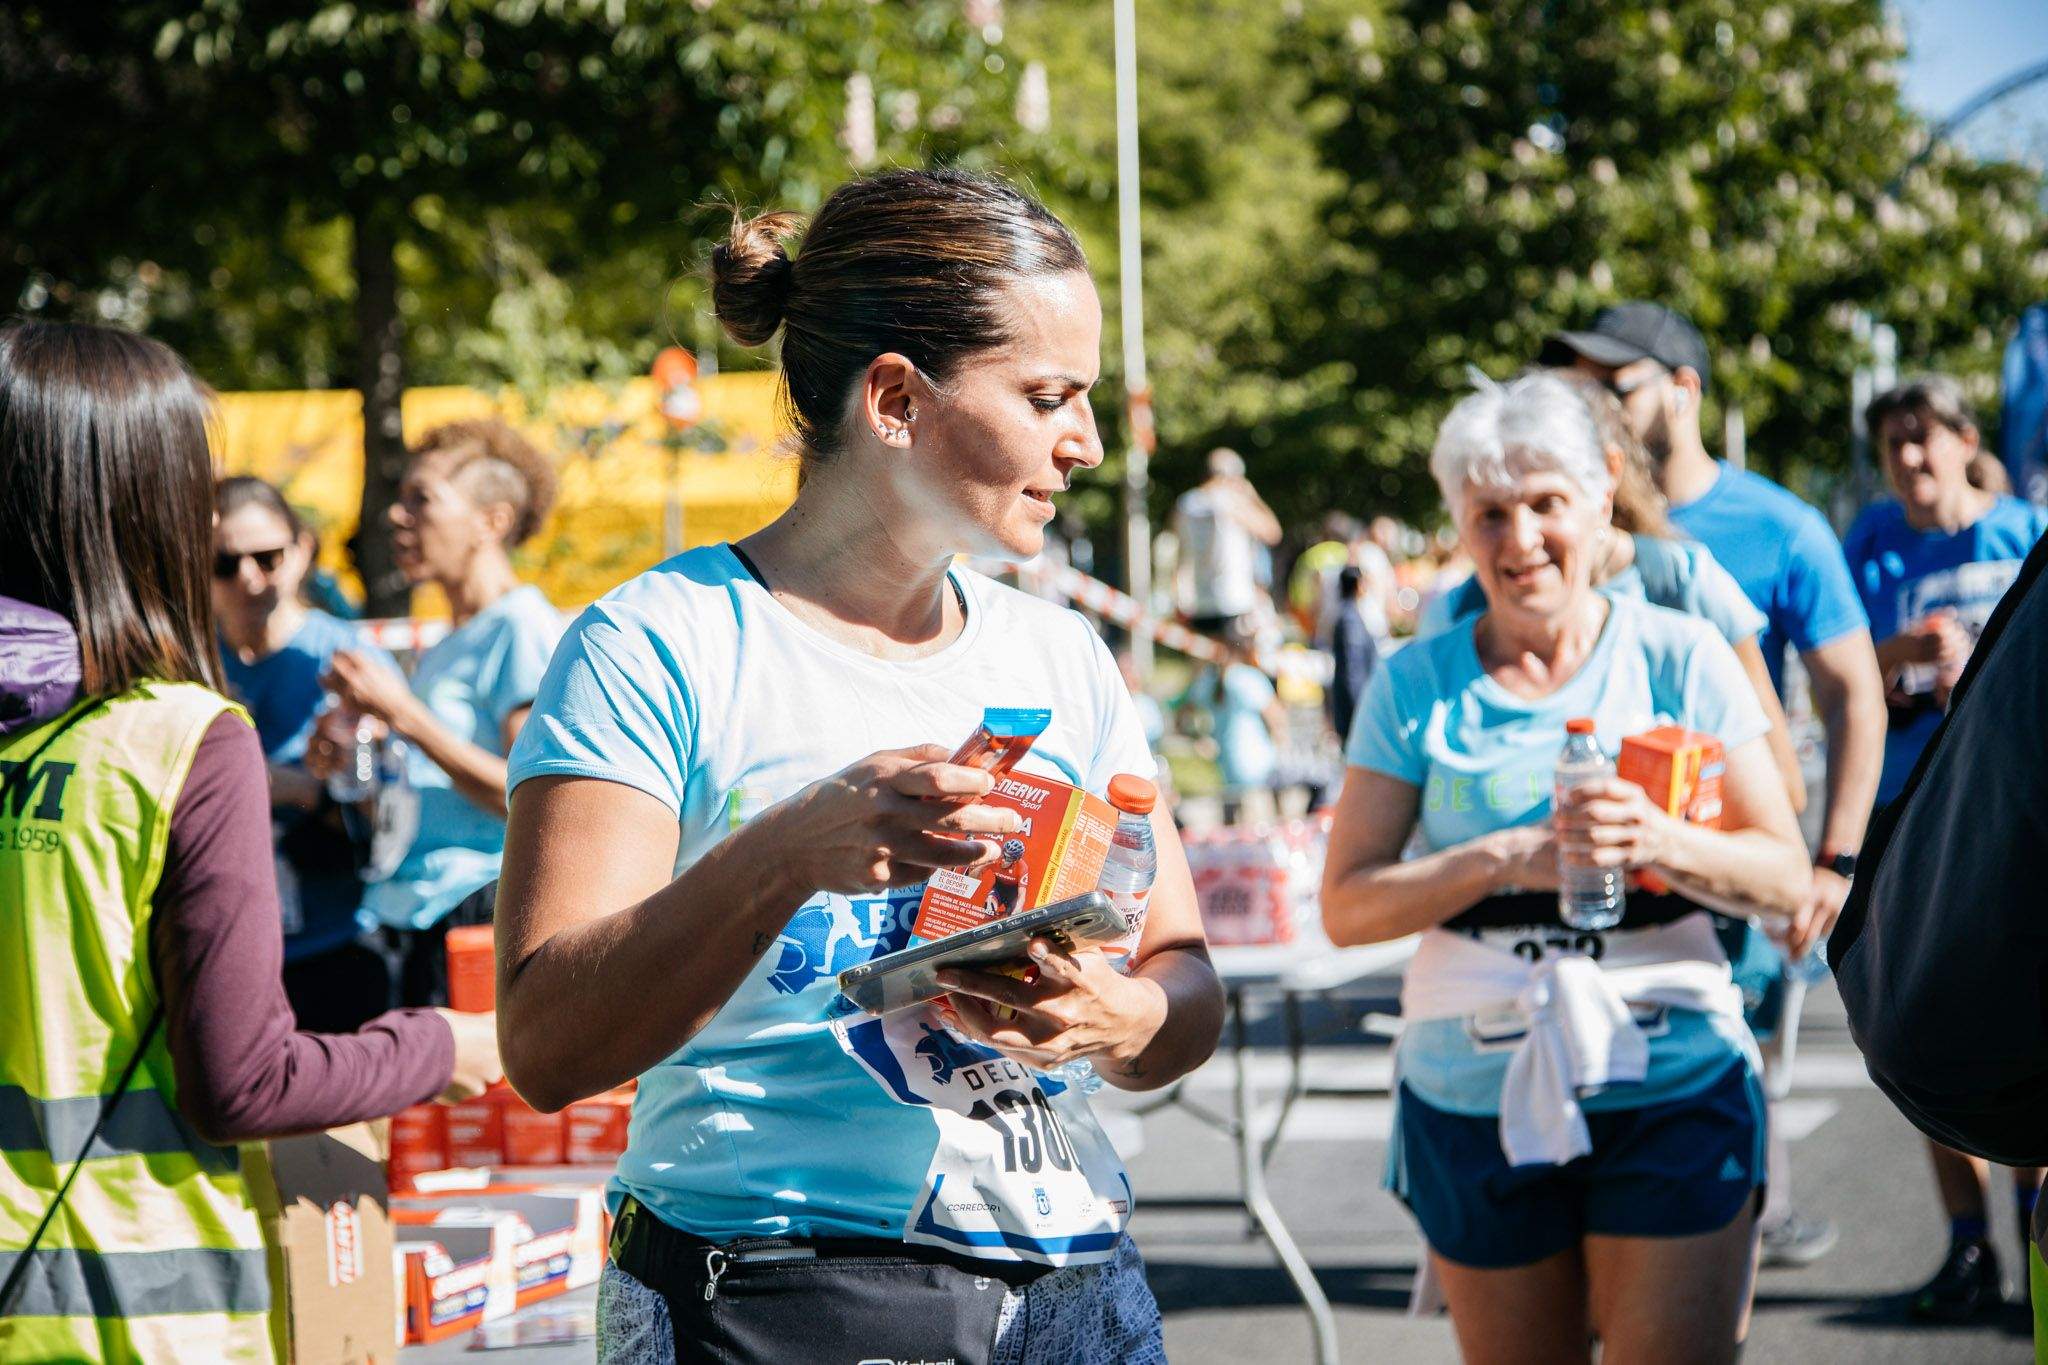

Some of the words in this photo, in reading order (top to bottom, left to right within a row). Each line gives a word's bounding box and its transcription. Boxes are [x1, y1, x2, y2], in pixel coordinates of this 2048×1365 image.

[994, 778, 1050, 803] NERVIT
[1020, 799, 1041, 811] Sport
[12, 826, 59, 853] 1959
[940, 870, 964, 882] DURANTE
[945, 878, 969, 890] DEPORTE
